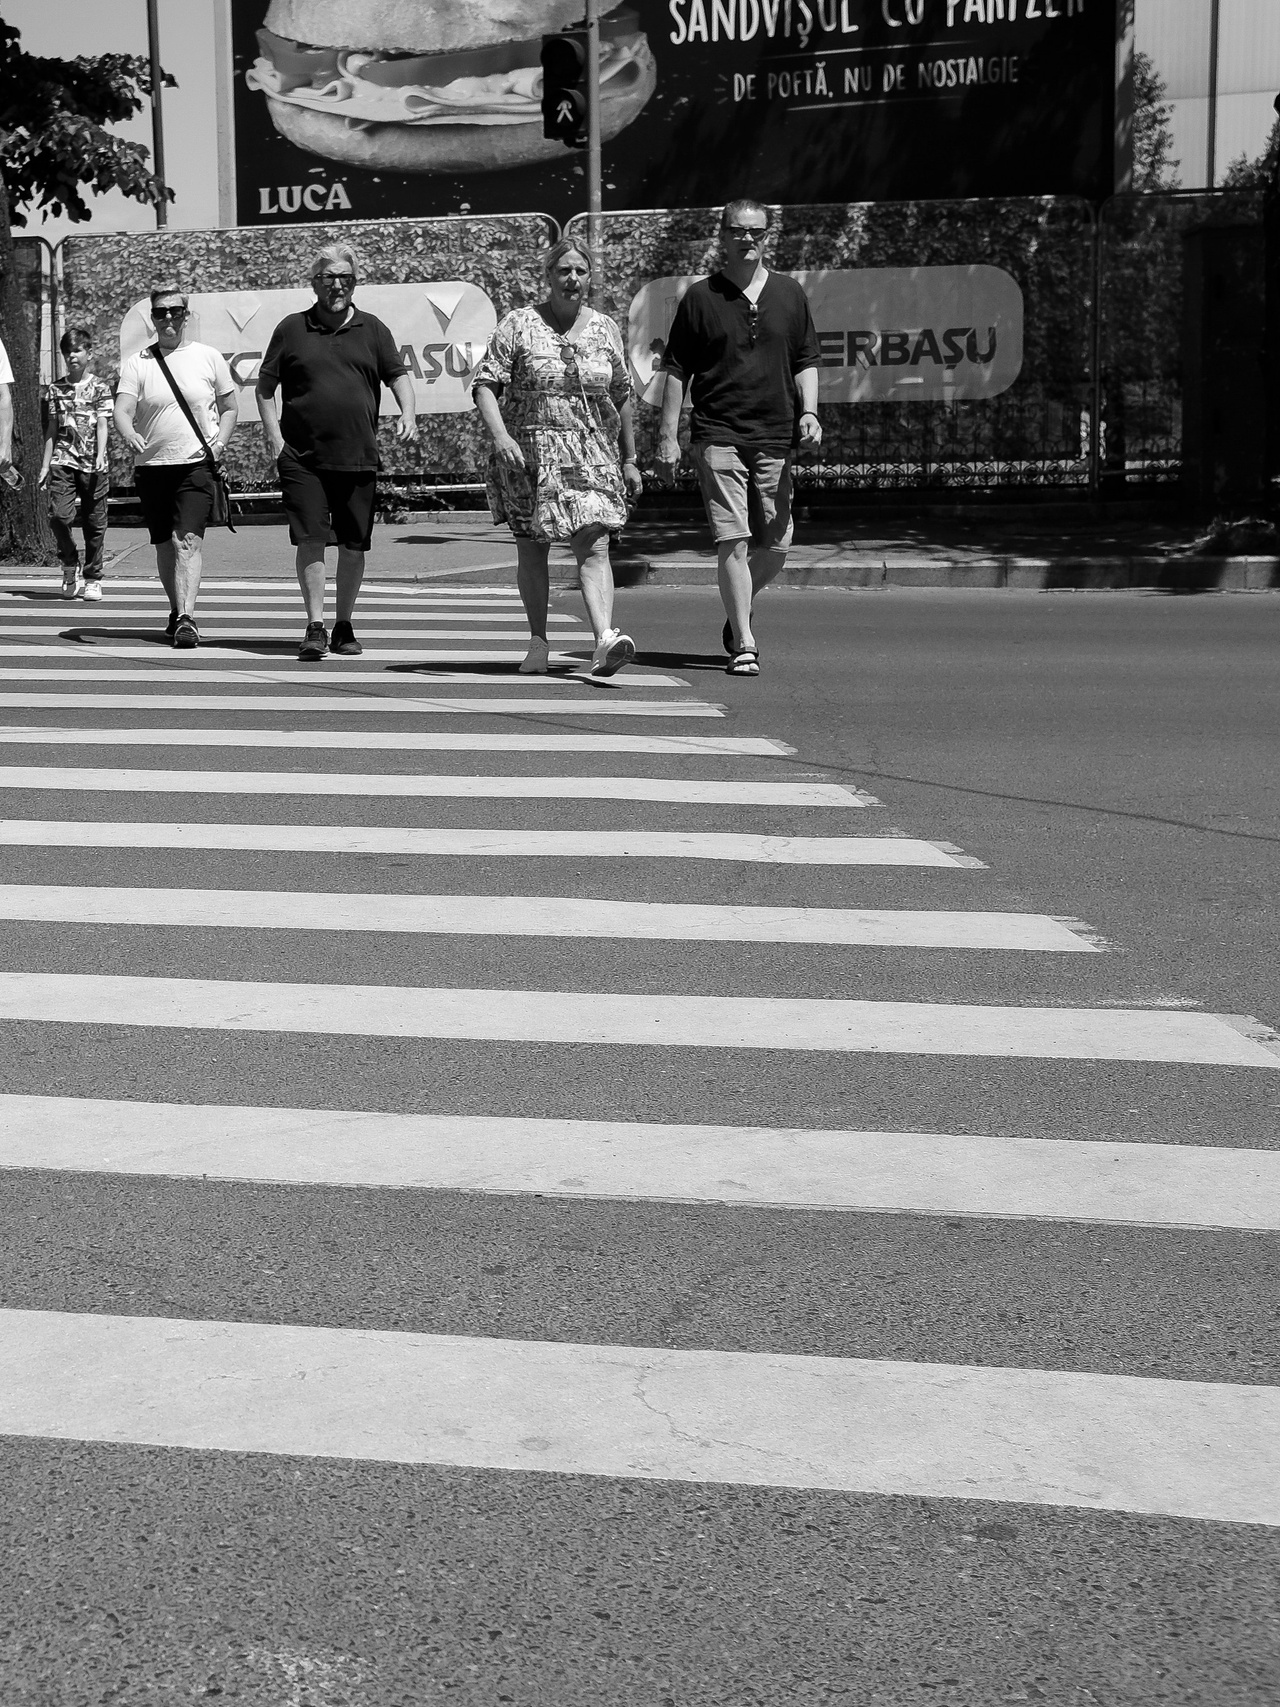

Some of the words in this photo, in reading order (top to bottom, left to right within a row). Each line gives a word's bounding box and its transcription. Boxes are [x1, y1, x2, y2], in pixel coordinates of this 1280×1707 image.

[733, 72, 757, 102] DE
[844, 66, 873, 95] NU
[882, 63, 907, 93] DE
[918, 56, 1019, 89] NOSTALGIE
[258, 183, 352, 214] LUCA
